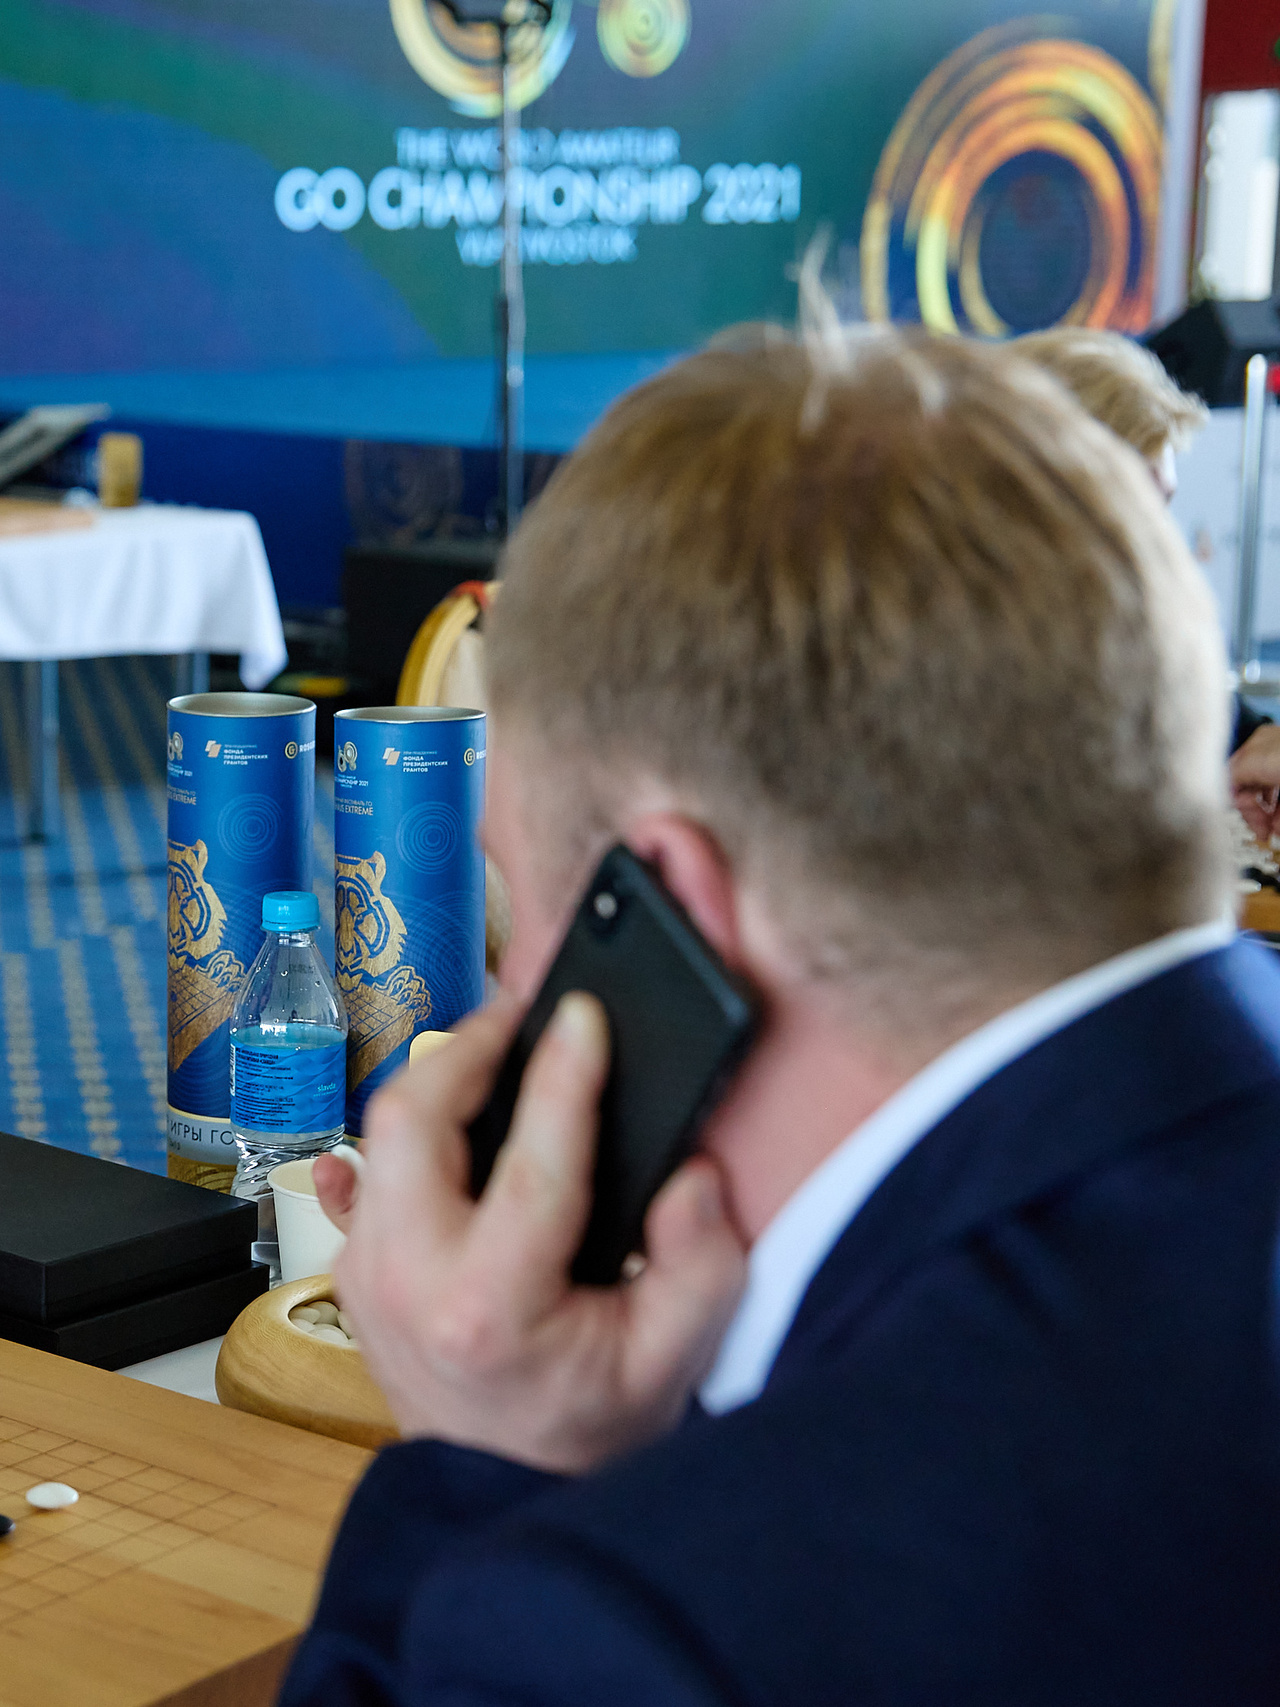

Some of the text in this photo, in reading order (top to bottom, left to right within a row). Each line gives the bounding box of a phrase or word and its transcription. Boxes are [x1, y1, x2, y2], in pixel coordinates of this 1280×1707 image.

[274, 166, 366, 231] GO
[702, 162, 801, 225] 2021
[345, 805, 374, 816] EXTREME
[170, 1120, 202, 1142] ИГРЫ
